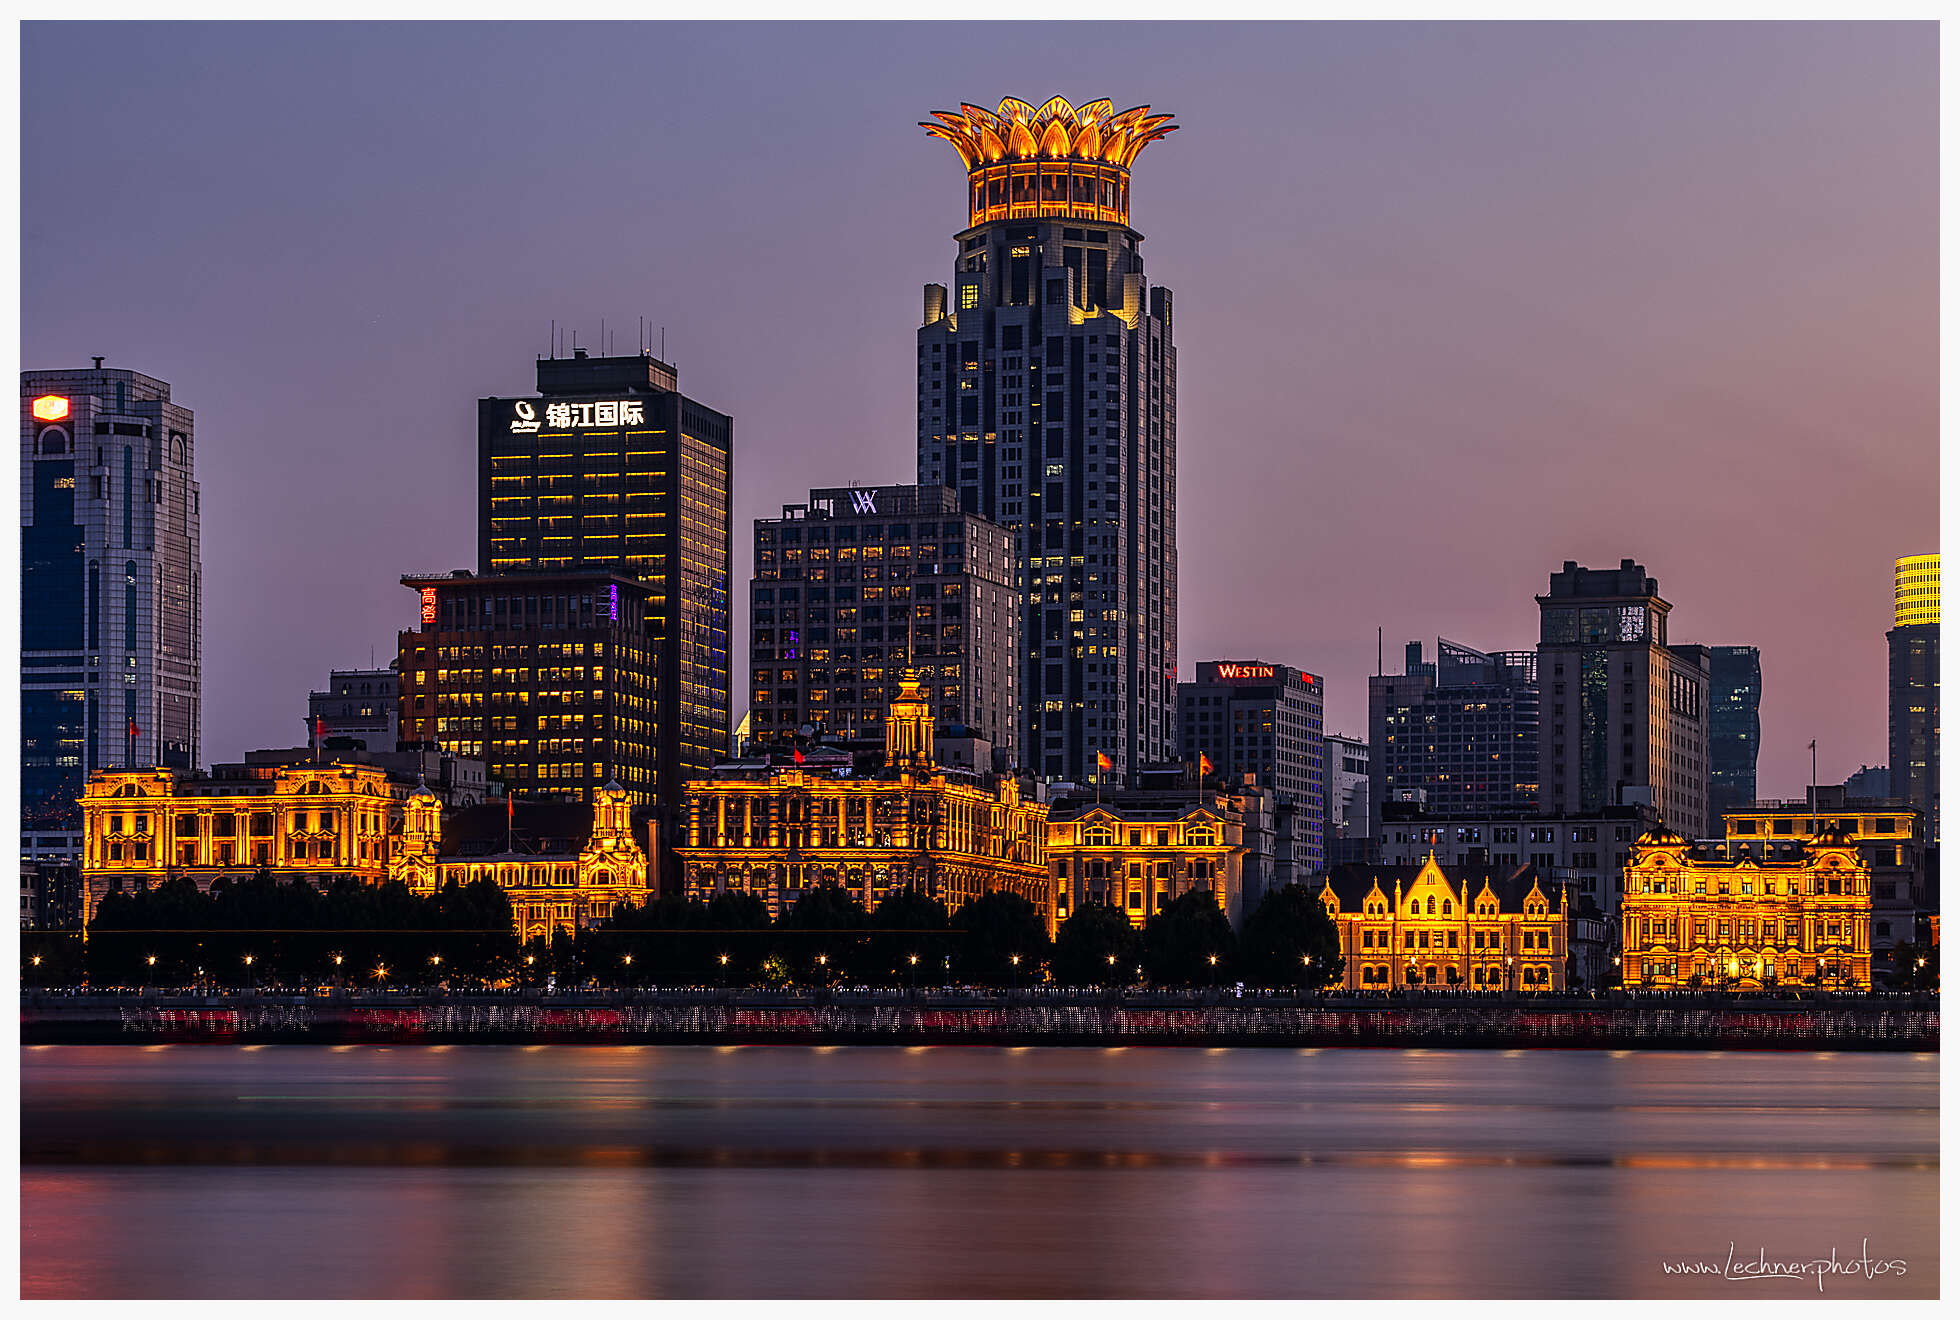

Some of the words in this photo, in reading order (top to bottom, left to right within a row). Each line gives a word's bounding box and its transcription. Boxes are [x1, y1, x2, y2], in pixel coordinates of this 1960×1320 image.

[545, 401, 644, 428] 锦江国际
[1218, 664, 1274, 679] WESTIN
